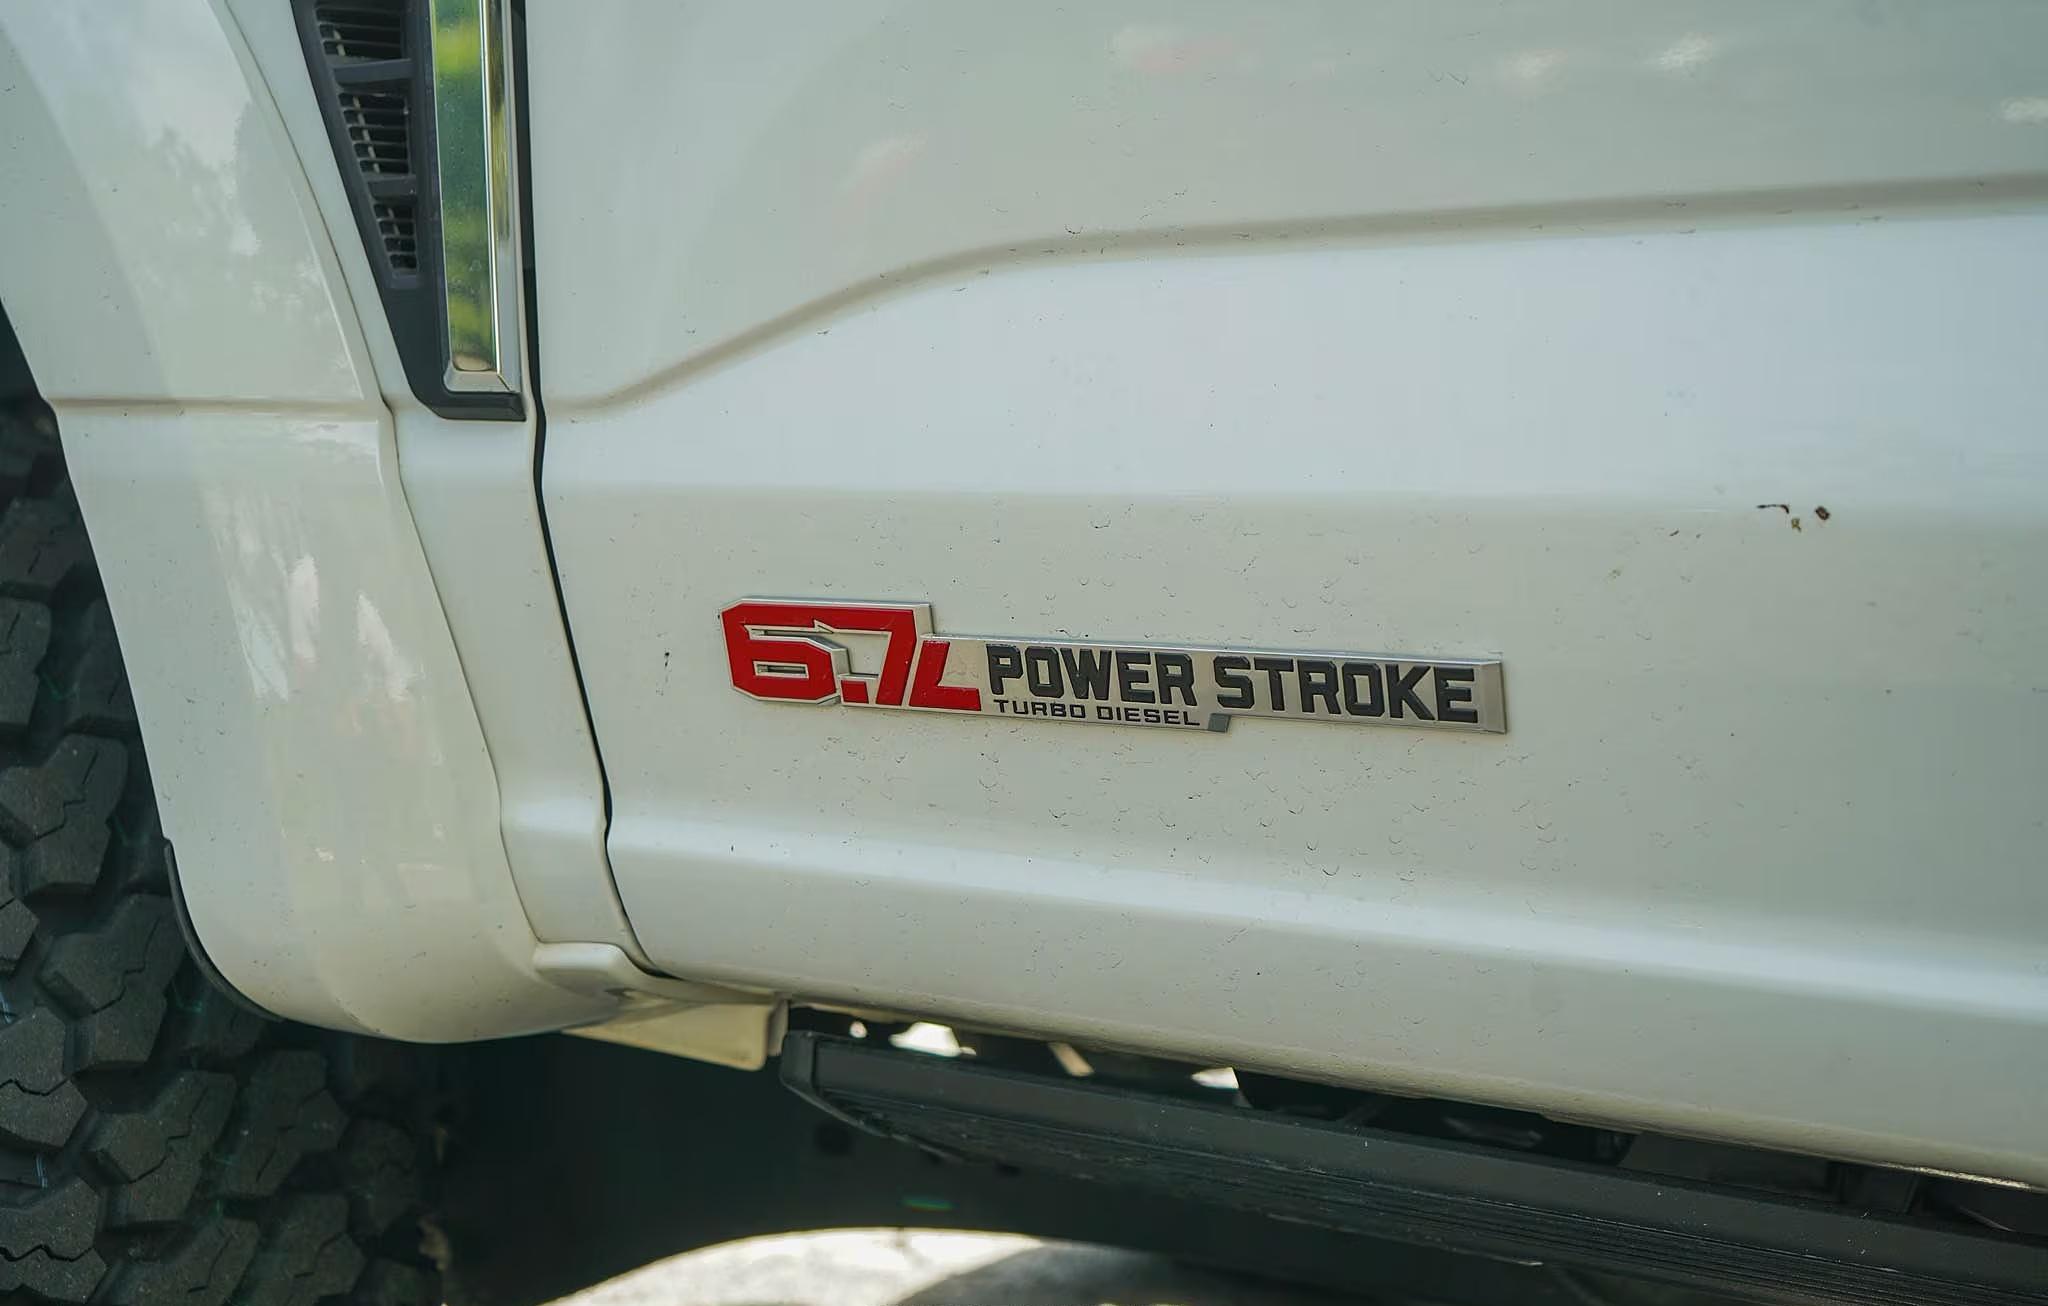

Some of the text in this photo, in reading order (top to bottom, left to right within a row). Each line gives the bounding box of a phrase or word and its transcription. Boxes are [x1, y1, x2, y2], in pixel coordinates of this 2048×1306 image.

[721, 602, 1479, 724] 6.7L POWER STROKE
[994, 699, 1201, 727] TURBO DIESEL
